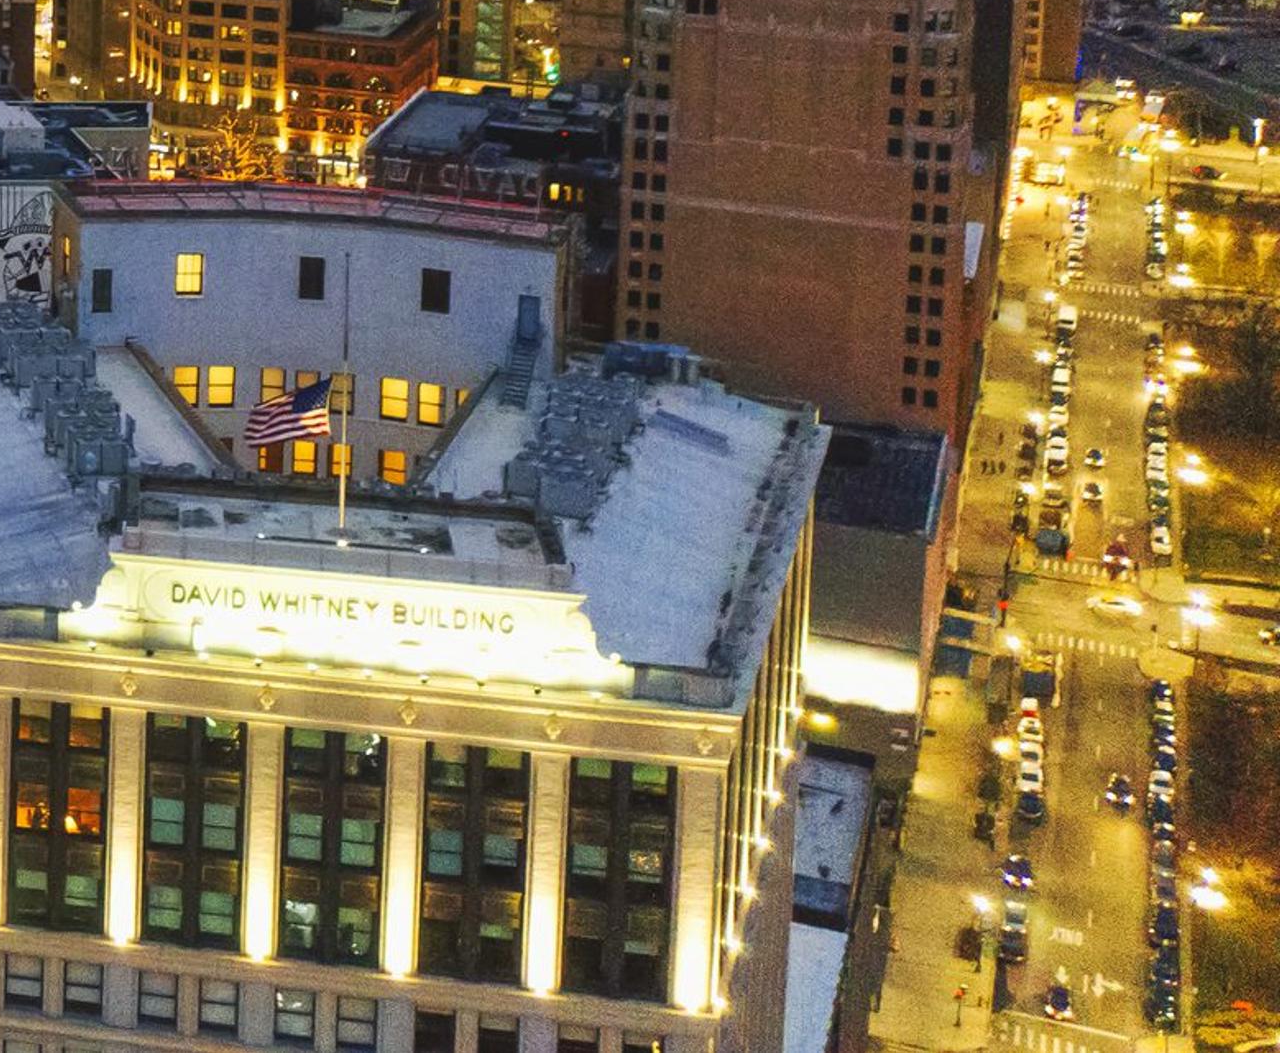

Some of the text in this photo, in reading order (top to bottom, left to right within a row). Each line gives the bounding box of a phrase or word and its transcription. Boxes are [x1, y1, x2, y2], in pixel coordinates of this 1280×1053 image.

[171, 584, 515, 634] DAVID WHITNEY BUILDING
